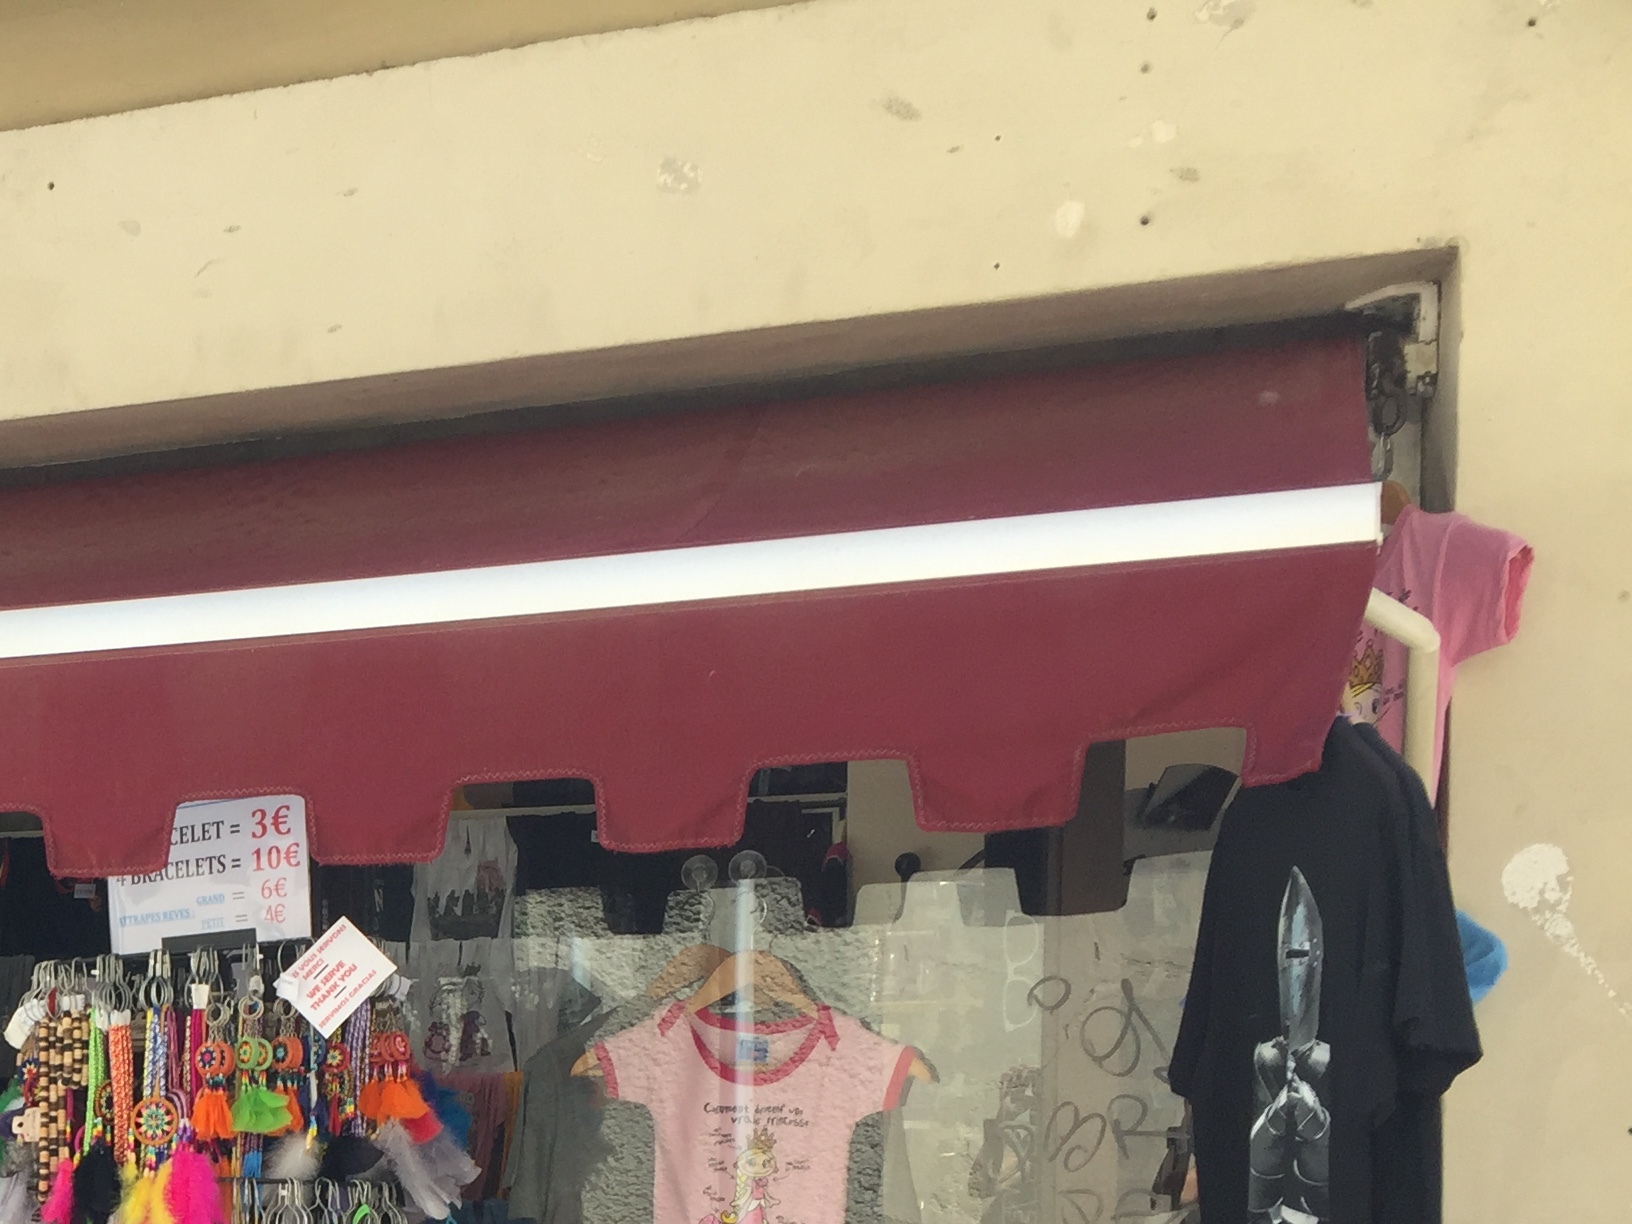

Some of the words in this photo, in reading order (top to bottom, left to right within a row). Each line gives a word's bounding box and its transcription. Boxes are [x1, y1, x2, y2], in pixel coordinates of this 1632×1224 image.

[251, 805, 292, 839] 3€
[252, 842, 301, 872] 10€
[261, 877, 287, 899] 6€
[264, 904, 286, 924] 4€
[310, 981, 339, 1011] THANK
[339, 963, 358, 982] YOU
[321, 960, 346, 986] SERVE
